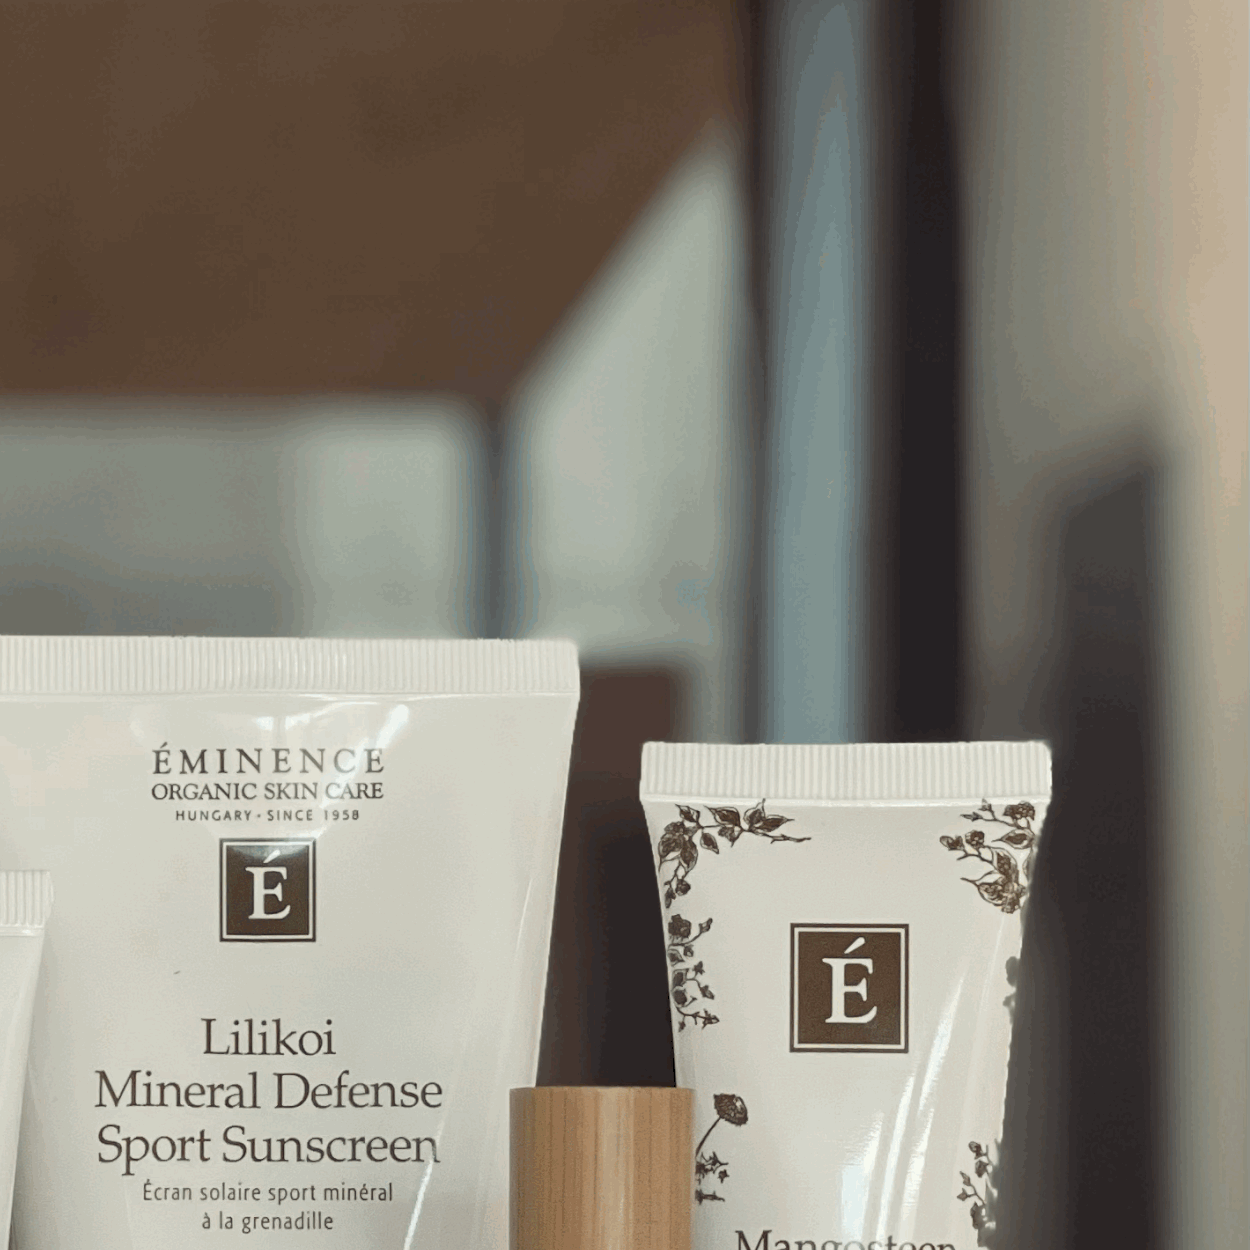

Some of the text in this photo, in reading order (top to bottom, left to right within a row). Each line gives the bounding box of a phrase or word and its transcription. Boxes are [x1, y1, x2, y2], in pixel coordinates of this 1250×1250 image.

[152, 742, 385, 776] ÉMINENCE
[151, 782, 384, 802] ORGANIC SKIN CARE
[175, 810, 360, 822] HUNGARY SINCE 1958
[245, 849, 291, 921] É
[822, 936, 878, 1024] É
[201, 1018, 337, 1057] Lilikoi
[95, 1070, 443, 1110] Mineral Defense
[97, 1124, 441, 1177] Sport Sunscreen
[143, 1179, 394, 1206] Écran solaire sport minéral
[202, 1211, 334, 1235] à la grenadille
